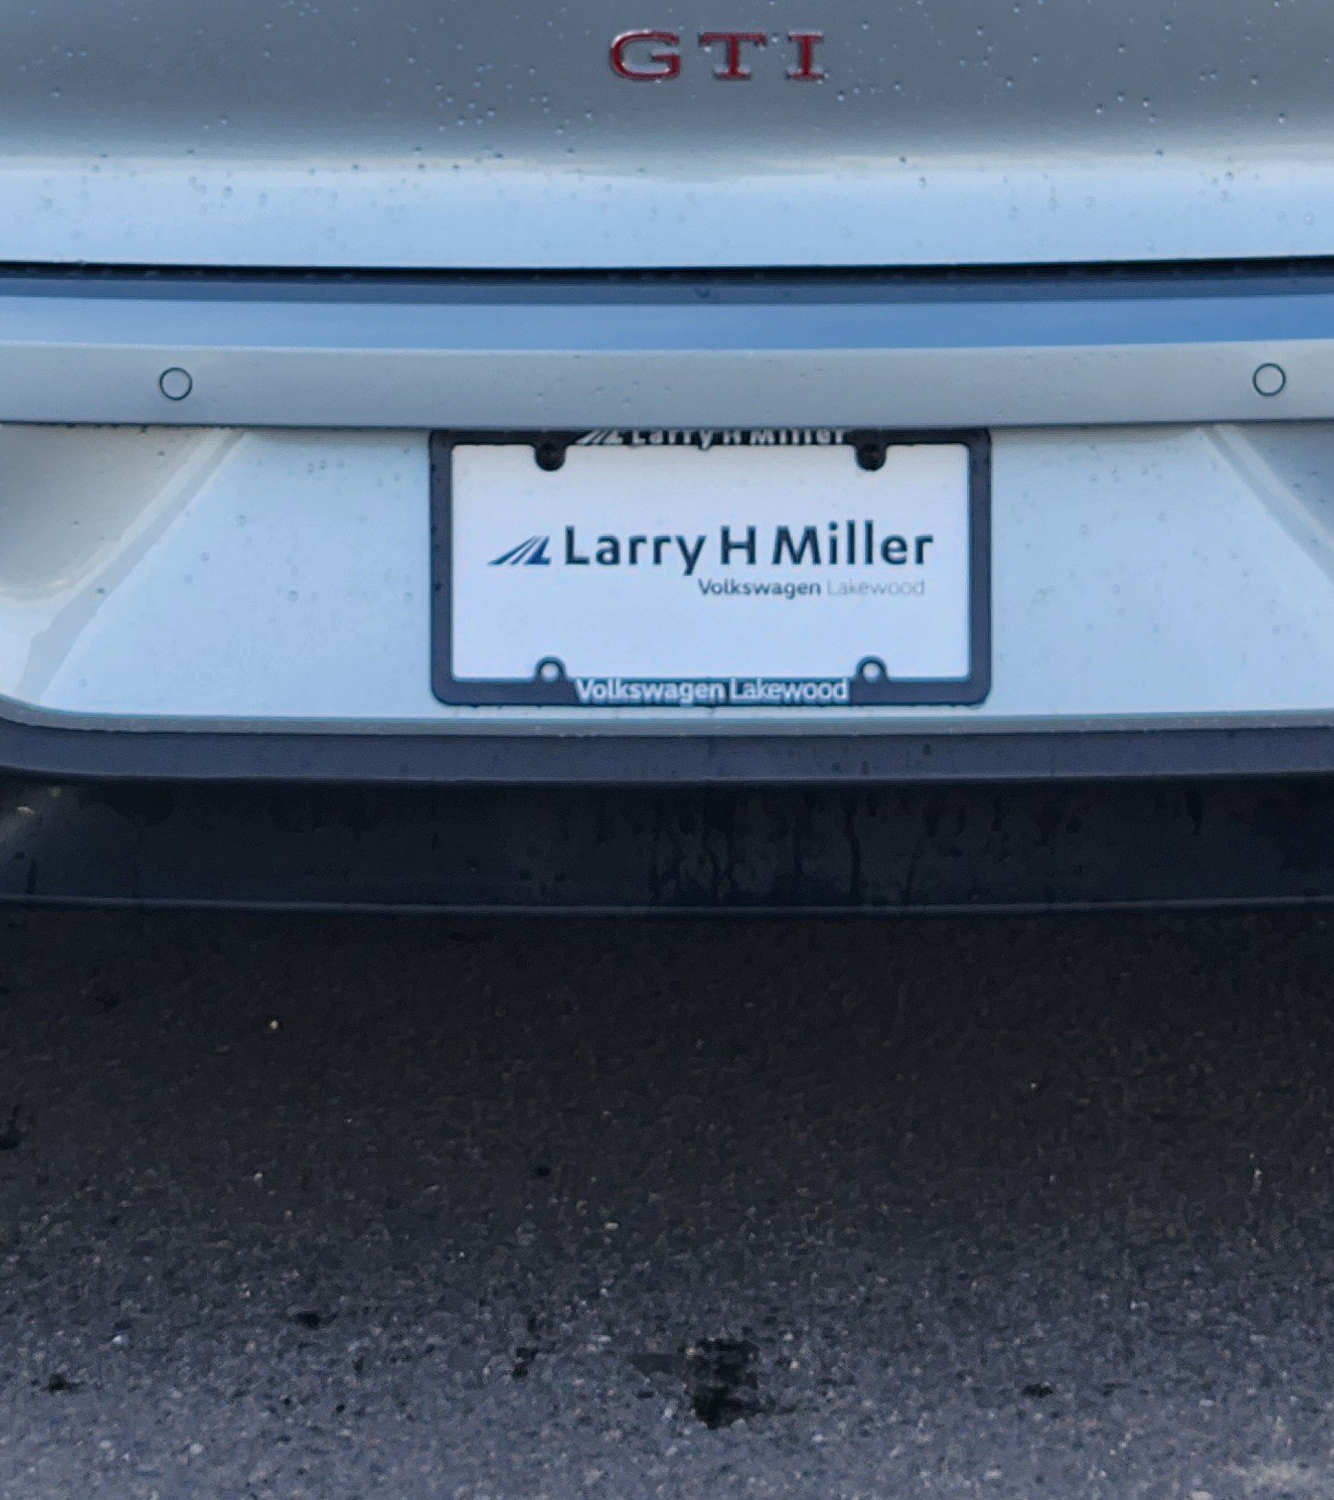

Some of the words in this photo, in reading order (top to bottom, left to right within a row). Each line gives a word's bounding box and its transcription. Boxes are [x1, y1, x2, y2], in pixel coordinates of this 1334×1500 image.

[609, 28, 828, 81] GTI
[631, 429, 711, 450] Larry
[750, 429, 846, 444] Miller
[565, 525, 706, 576] Larry
[720, 525, 757, 565] H
[772, 520, 934, 565] Miller
[697, 578, 822, 601] Volkswagen
[826, 578, 925, 597] Lakewood
[575, 677, 725, 706] Volkswagen
[729, 677, 849, 701] Lakewood
